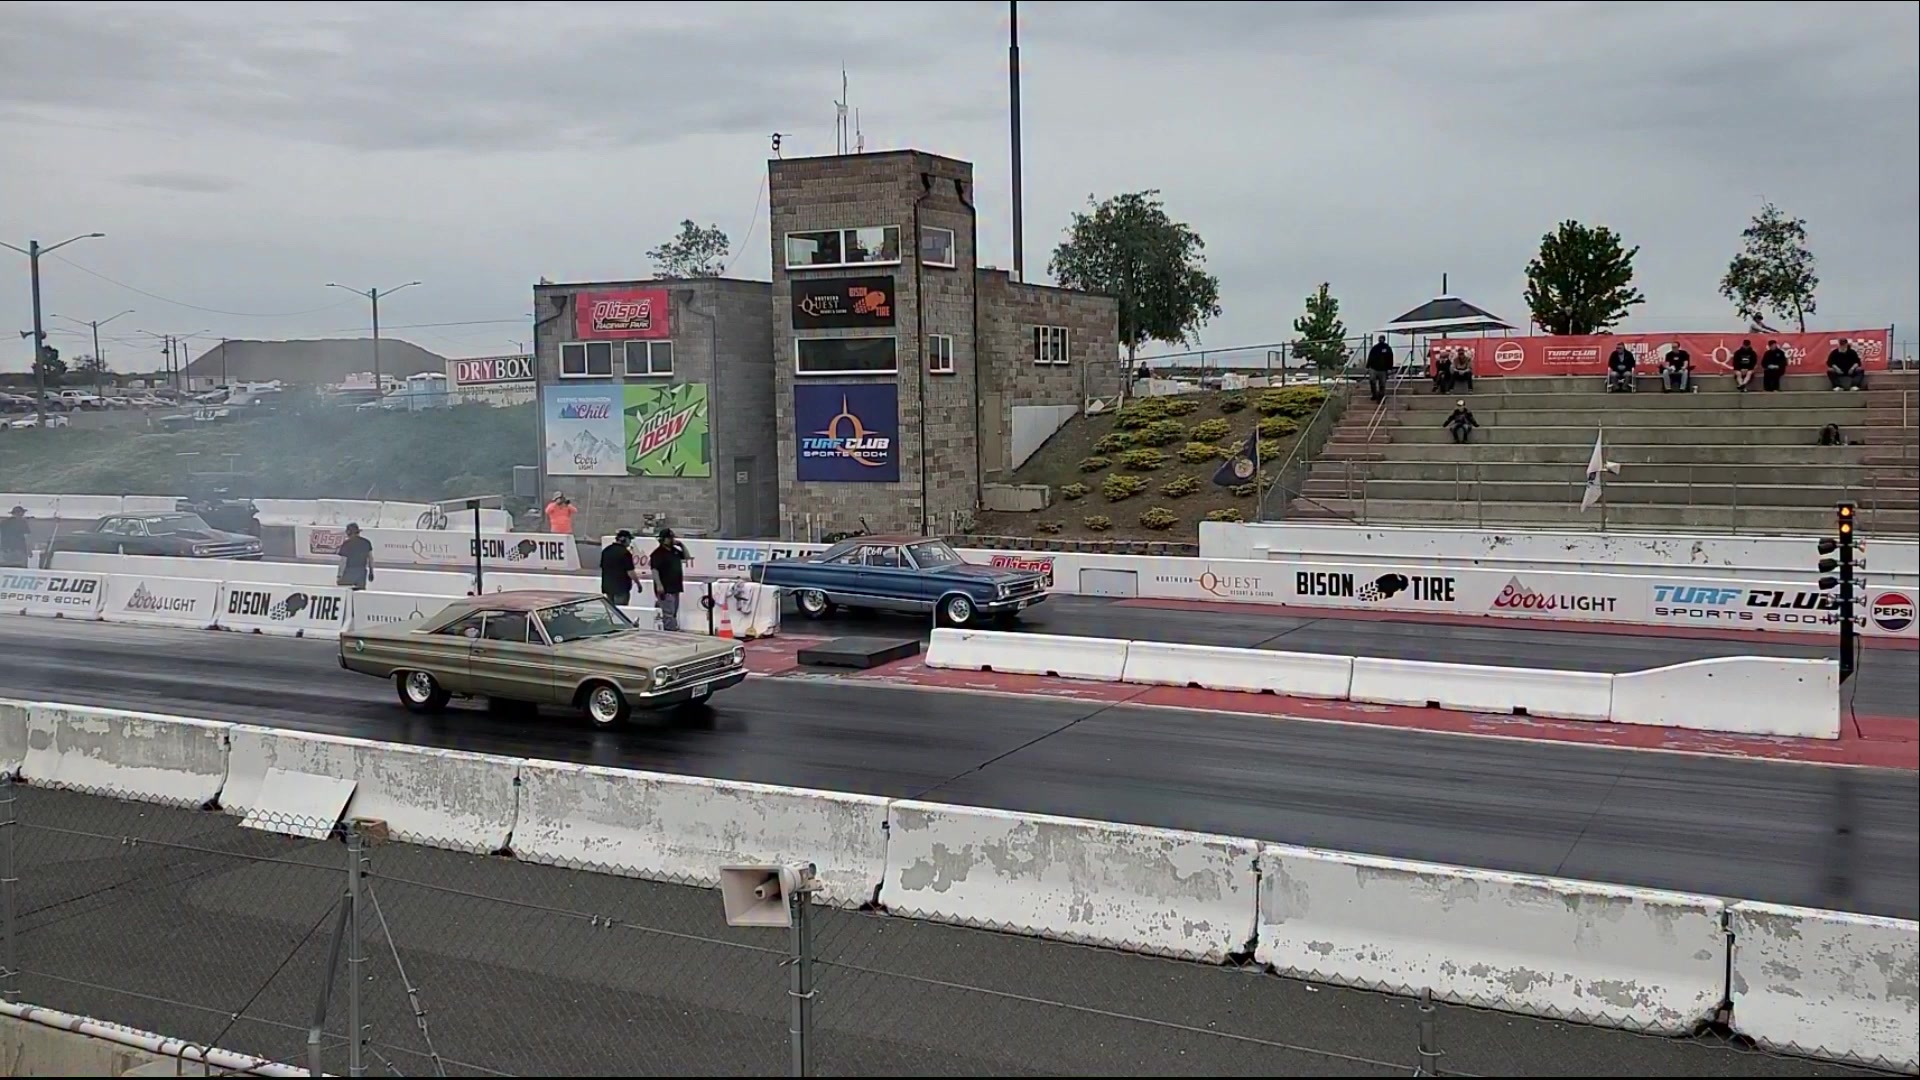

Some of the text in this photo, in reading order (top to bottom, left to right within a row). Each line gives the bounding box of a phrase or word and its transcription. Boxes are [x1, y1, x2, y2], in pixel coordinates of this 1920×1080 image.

[1497, 351, 1522, 360] PEPSI
[458, 358, 531, 381] DRYBOX
[576, 403, 611, 419] Chill
[802, 438, 890, 449] TURF CLUB
[573, 453, 599, 465] Coors
[538, 541, 565, 560] TIRE
[716, 547, 769, 561] TURF
[2, 574, 97, 594] TURF CLUB
[1198, 567, 1262, 597] QUEST
[1296, 571, 1456, 602] BISON TIRE
[0, 592, 92, 606] SPORTS BOOK
[127, 587, 197, 613] Coors LIGHT
[1493, 584, 1618, 613] Coors LIGHT
[1653, 585, 1743, 606] TURF
[228, 590, 342, 621] BISON TIRE
[1654, 606, 1754, 621] SPORTS
[1873, 606, 1914, 618] PEPSI
